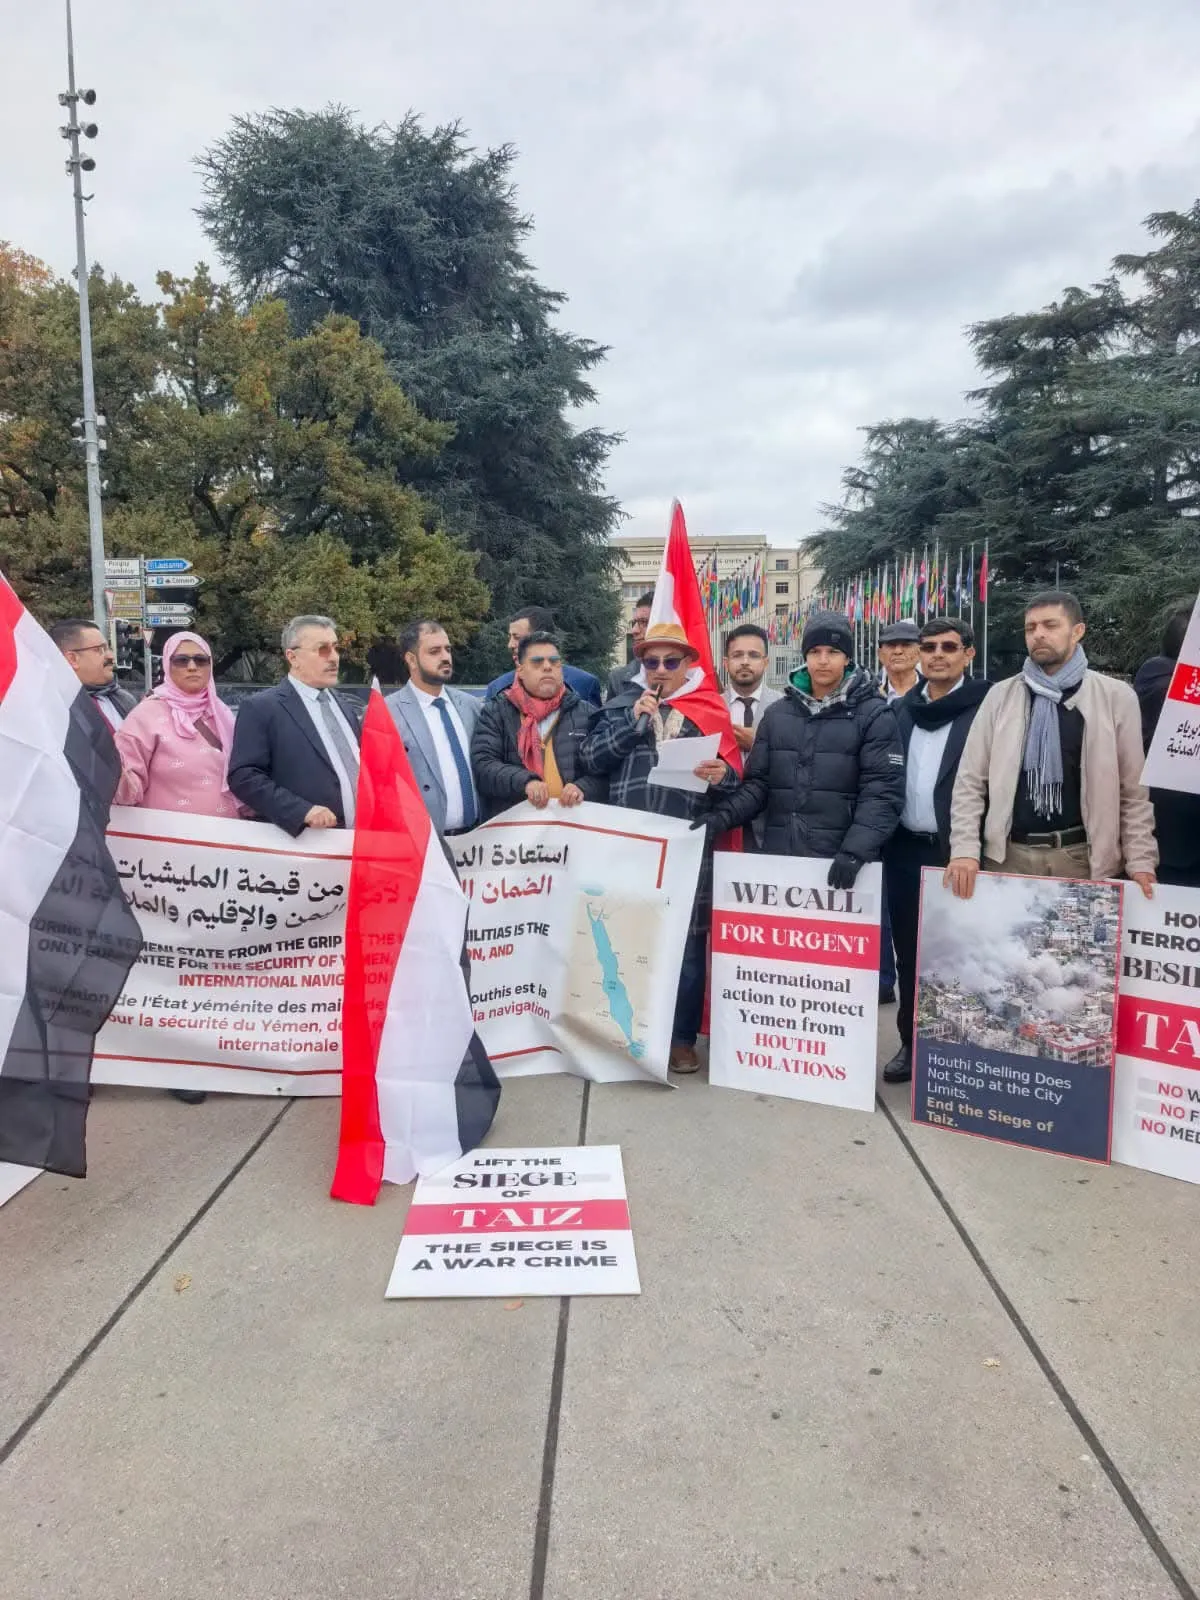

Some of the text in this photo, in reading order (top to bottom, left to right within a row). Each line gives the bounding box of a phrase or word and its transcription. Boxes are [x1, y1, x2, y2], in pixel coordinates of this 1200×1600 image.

[491, 842, 568, 867] استعادة
[237, 868, 300, 903] قبضة
[308, 882, 344, 902] من
[482, 874, 553, 904] الضمان
[732, 881, 862, 914] WE CALL
[176, 946, 224, 959] STATE
[228, 943, 272, 959] FROM
[276, 938, 305, 952] THE
[307, 935, 342, 949] GRIP
[514, 924, 525, 936] IS
[527, 922, 550, 936] THE
[720, 922, 870, 955] FOR URGENT
[178, 957, 209, 970] FOR
[212, 962, 242, 970] THE
[245, 955, 316, 971] SECURITY
[318, 954, 338, 967] OF
[489, 943, 514, 959] AND
[178, 973, 298, 988] INTERNATIONAL
[736, 965, 852, 994] international
[115, 994, 138, 1007] de
[191, 999, 273, 1013] yéménite
[277, 1000, 307, 1013] des
[311, 998, 342, 1012] mai
[471, 985, 512, 1004] outhis
[515, 982, 535, 994] est
[538, 983, 547, 998] la
[722, 988, 865, 1018] action to protect
[139, 1013, 154, 1028] la
[158, 1016, 229, 1030] sécurité
[232, 1018, 256, 1031] du
[261, 1020, 322, 1033] Yémen,
[473, 1009, 485, 1022] la
[488, 1001, 551, 1020] navigation
[738, 1008, 846, 1037] Yemen from
[218, 1036, 339, 1053] internationale
[755, 1032, 827, 1056] HOUTHI
[736, 1050, 847, 1081] VIOLATIONS
[928, 1053, 1072, 1089] Houthi Shelling Does
[927, 1068, 1063, 1105] Not Stop at the City
[927, 1082, 969, 1100] Limits.
[1157, 1081, 1184, 1098] NO
[927, 1096, 1054, 1133] End the Siege of
[927, 1111, 959, 1128] Taiz.
[1160, 1103, 1185, 1119] NO
[1140, 1117, 1166, 1135] NO
[473, 1158, 562, 1167] LIFT THE
[452, 1171, 577, 1189] SIEGE
[501, 1190, 532, 1198] OF
[452, 1206, 584, 1228] TAIZ
[425, 1240, 608, 1254] THE SIEGE IS
[411, 1255, 618, 1271] A WAR CRIME
